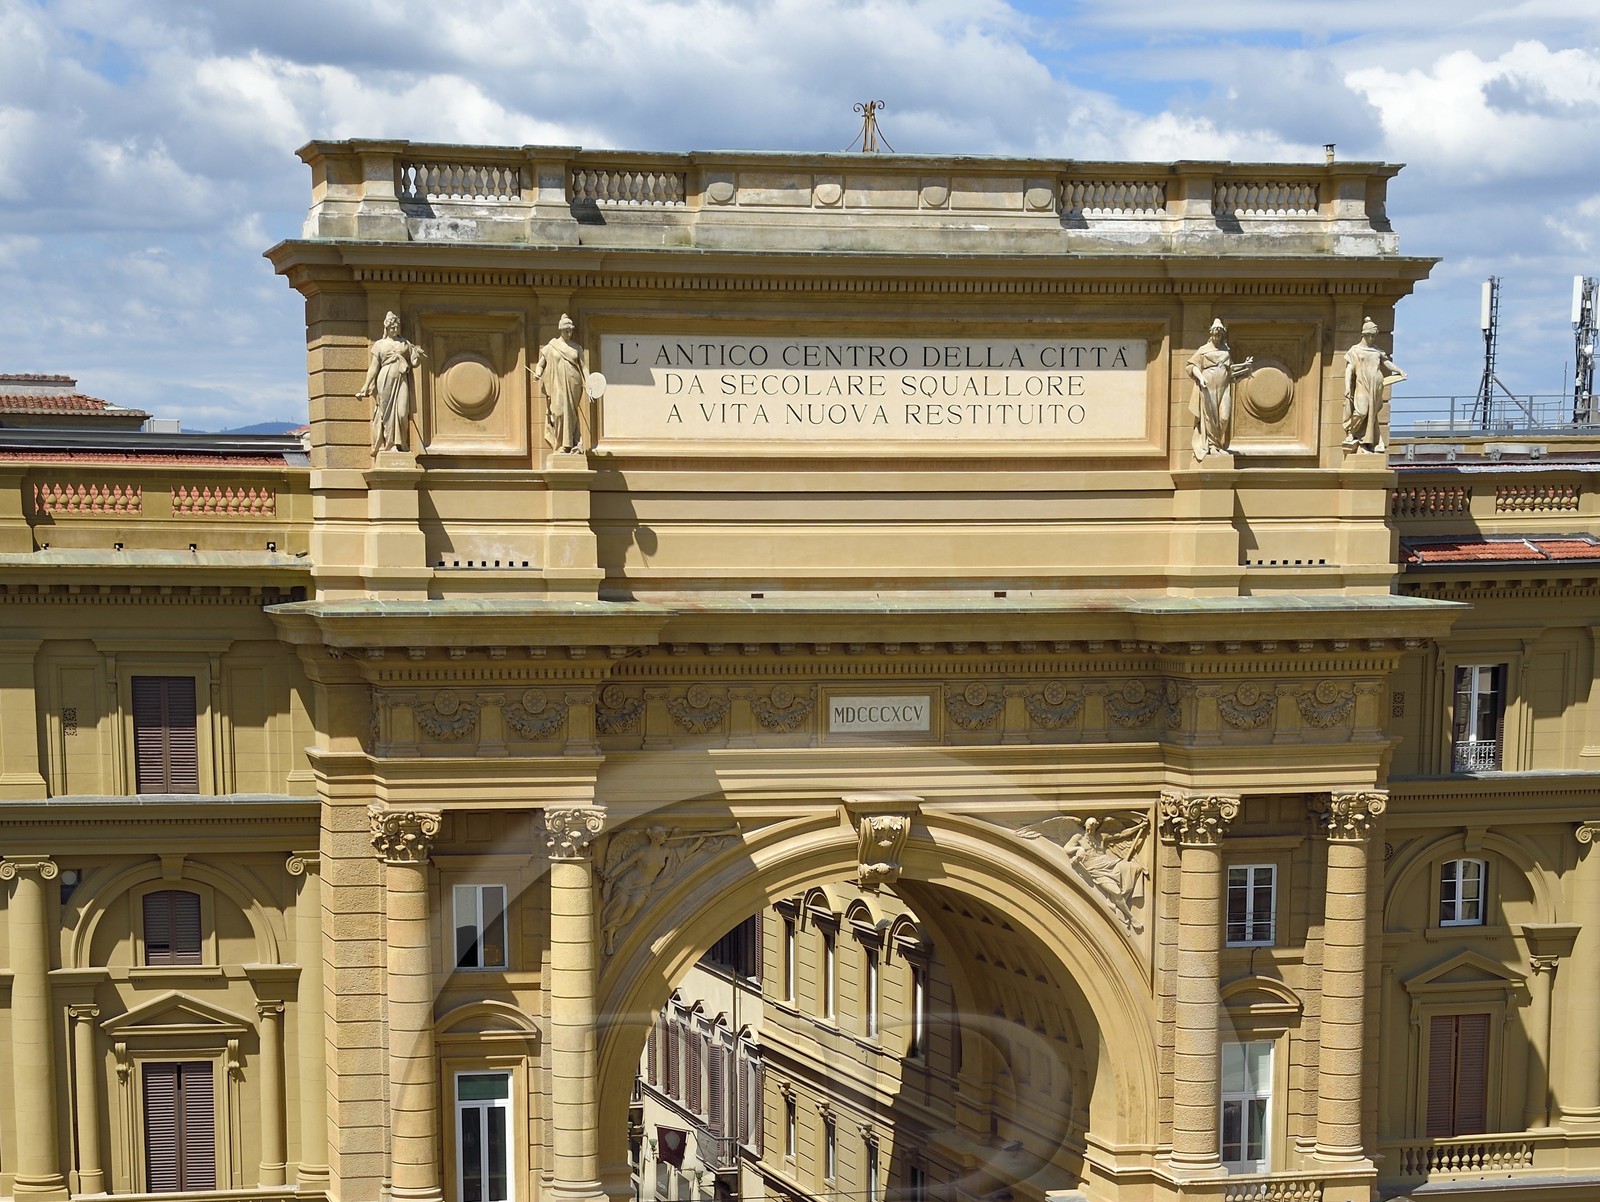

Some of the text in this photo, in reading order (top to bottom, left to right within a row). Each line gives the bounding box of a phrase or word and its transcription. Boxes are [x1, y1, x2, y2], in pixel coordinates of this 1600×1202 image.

[655, 344, 768, 367] ANTICO
[782, 344, 908, 368] CENTRO
[922, 346, 1025, 368] DELLA
[665, 373, 1085, 398] DA SECOLARE SQUALLORE
[666, 404, 1086, 425] A VITA NUOVA RESTITUITO
[834, 706, 923, 723] MDCCCXCV
